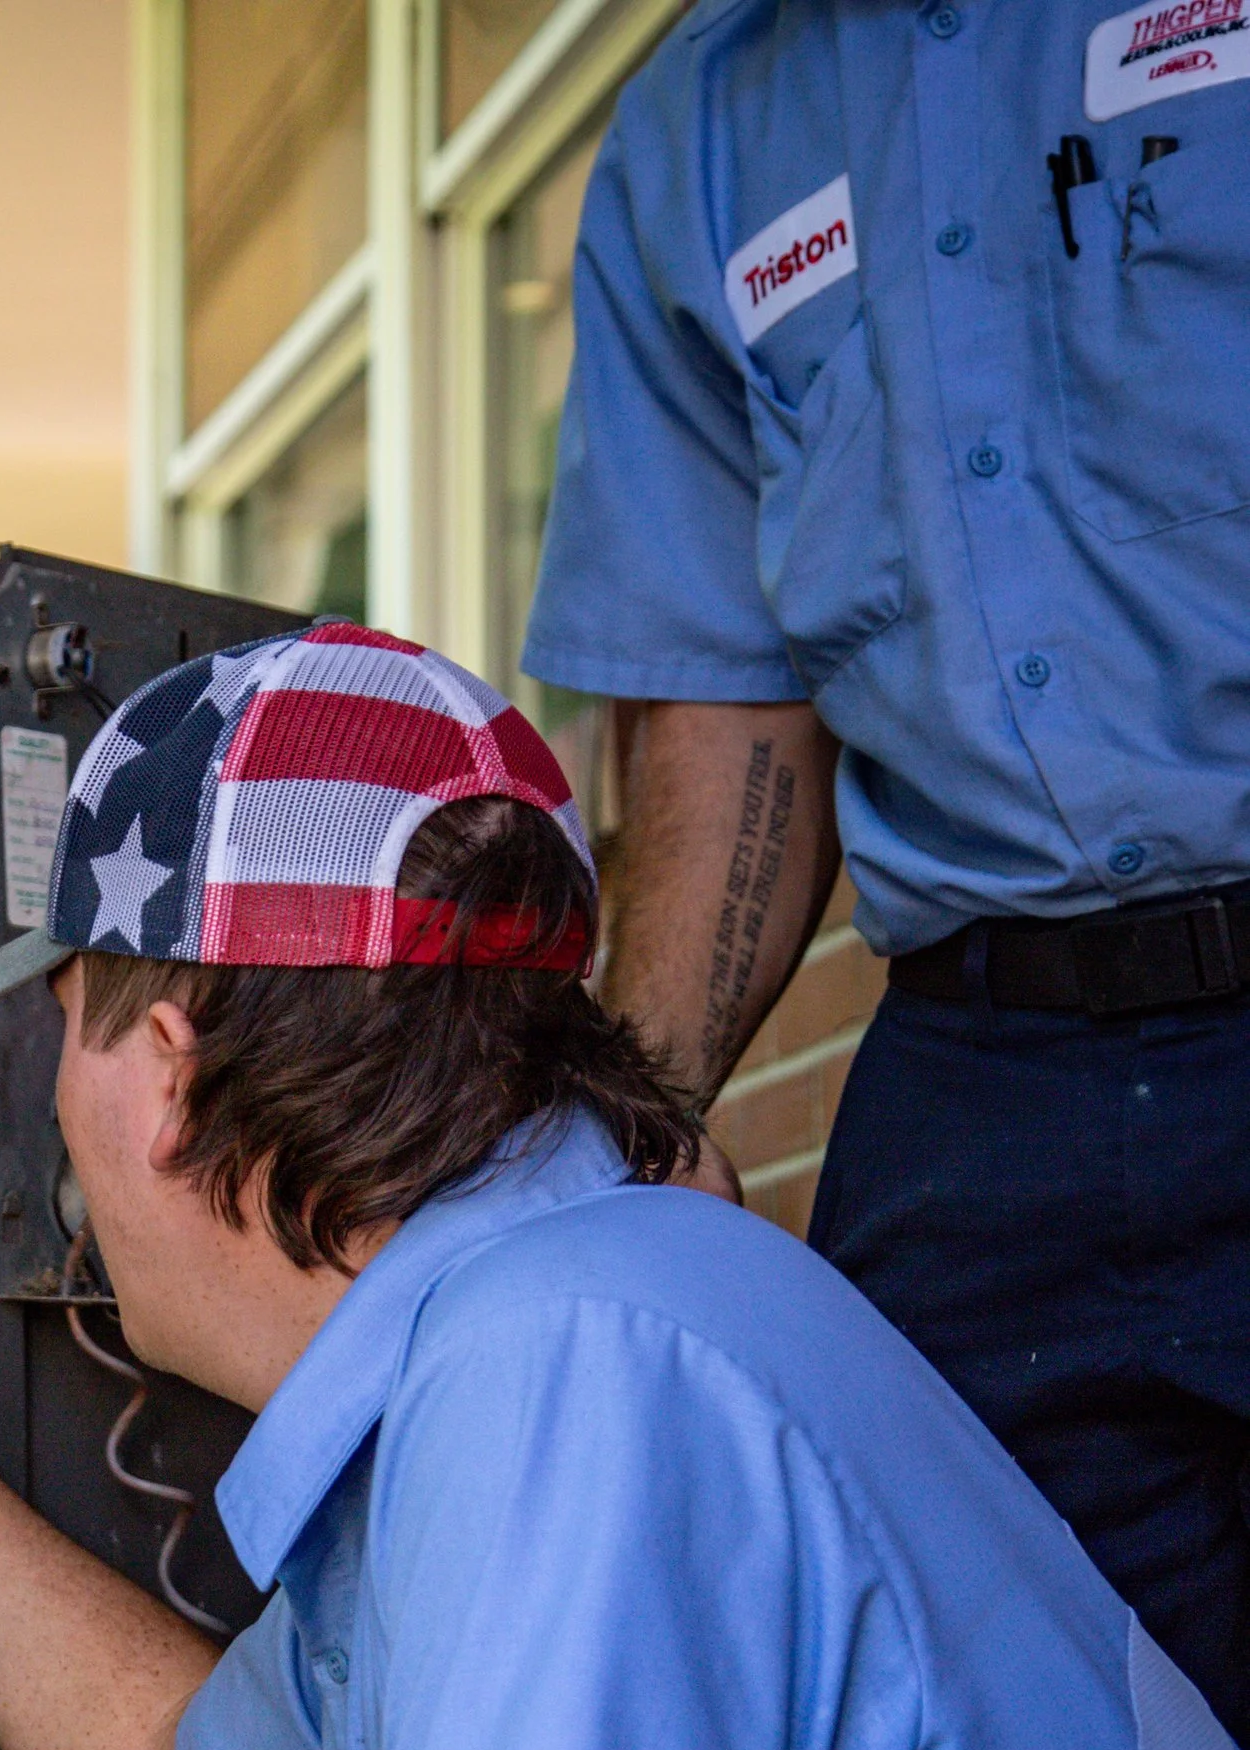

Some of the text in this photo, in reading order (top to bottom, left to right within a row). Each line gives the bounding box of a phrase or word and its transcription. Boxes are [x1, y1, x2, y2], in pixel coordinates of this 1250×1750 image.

[1132, 0, 1243, 44] THIGPEN
[745, 218, 847, 308] Triston
[727, 841, 753, 899] SETS
[717, 901, 738, 948] SON
